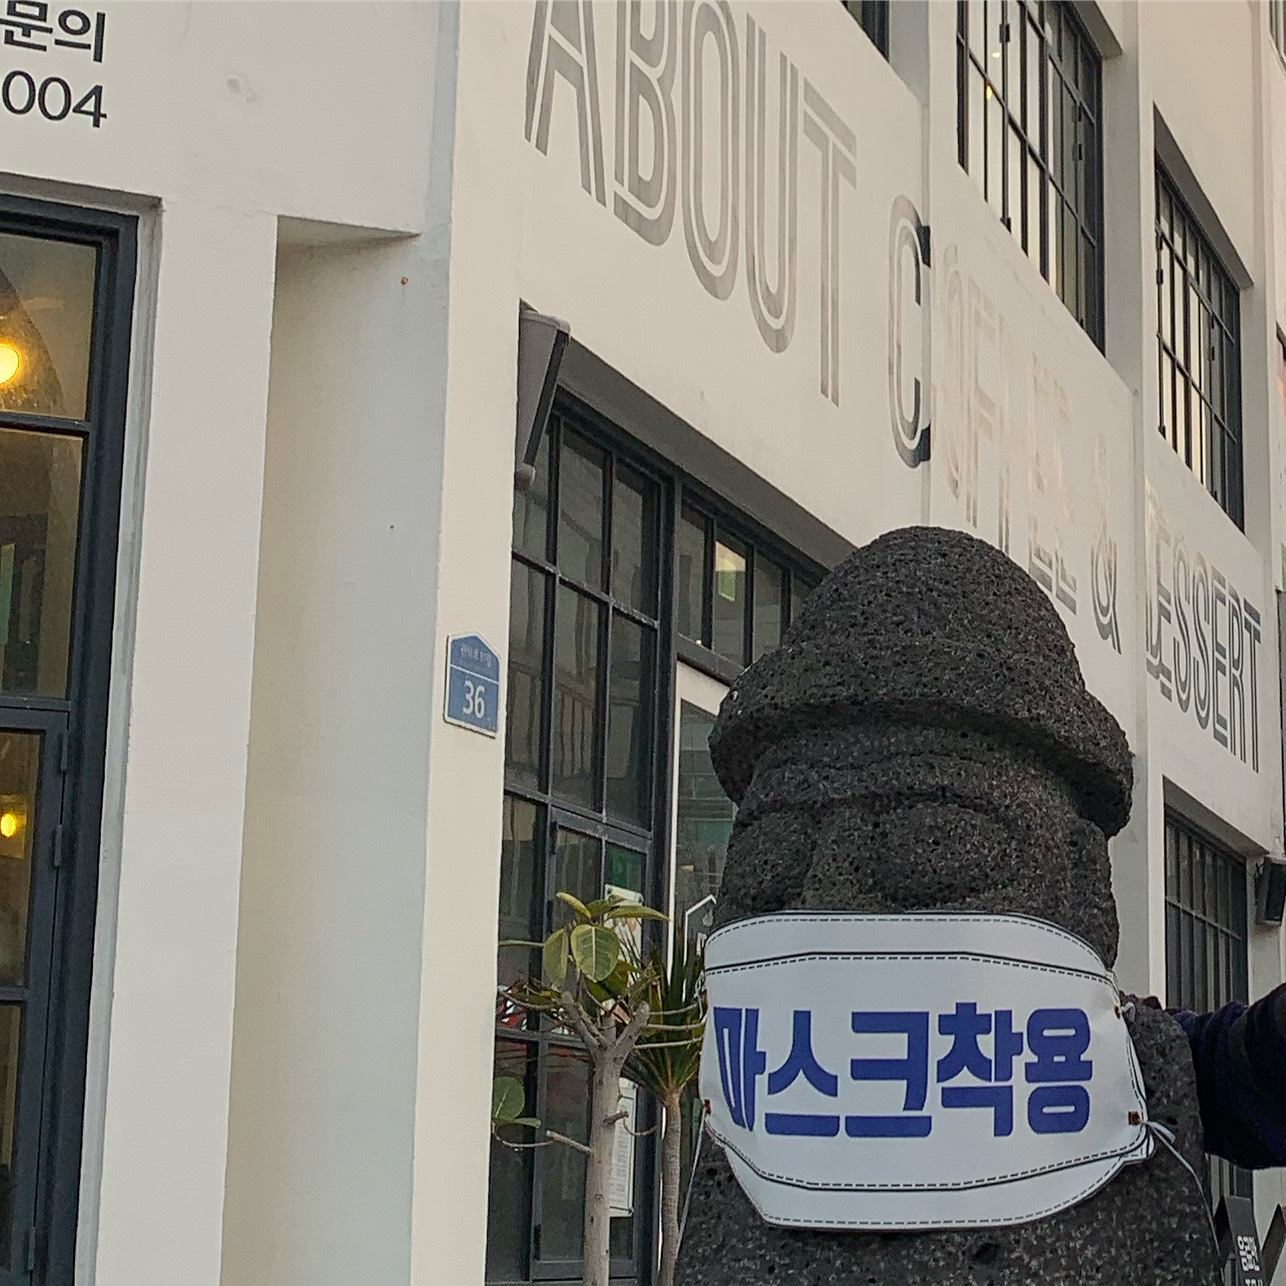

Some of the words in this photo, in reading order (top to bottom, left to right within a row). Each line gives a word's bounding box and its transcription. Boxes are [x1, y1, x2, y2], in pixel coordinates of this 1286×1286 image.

[0, 0, 106, 63] 문의
[2, 70, 107, 128] 004
[525, 0, 857, 407] ABOUT
[1146, 476, 1261, 774] DESSERT
[462, 680, 485, 718] 36
[713, 1002, 1093, 1137] 마스크착용
